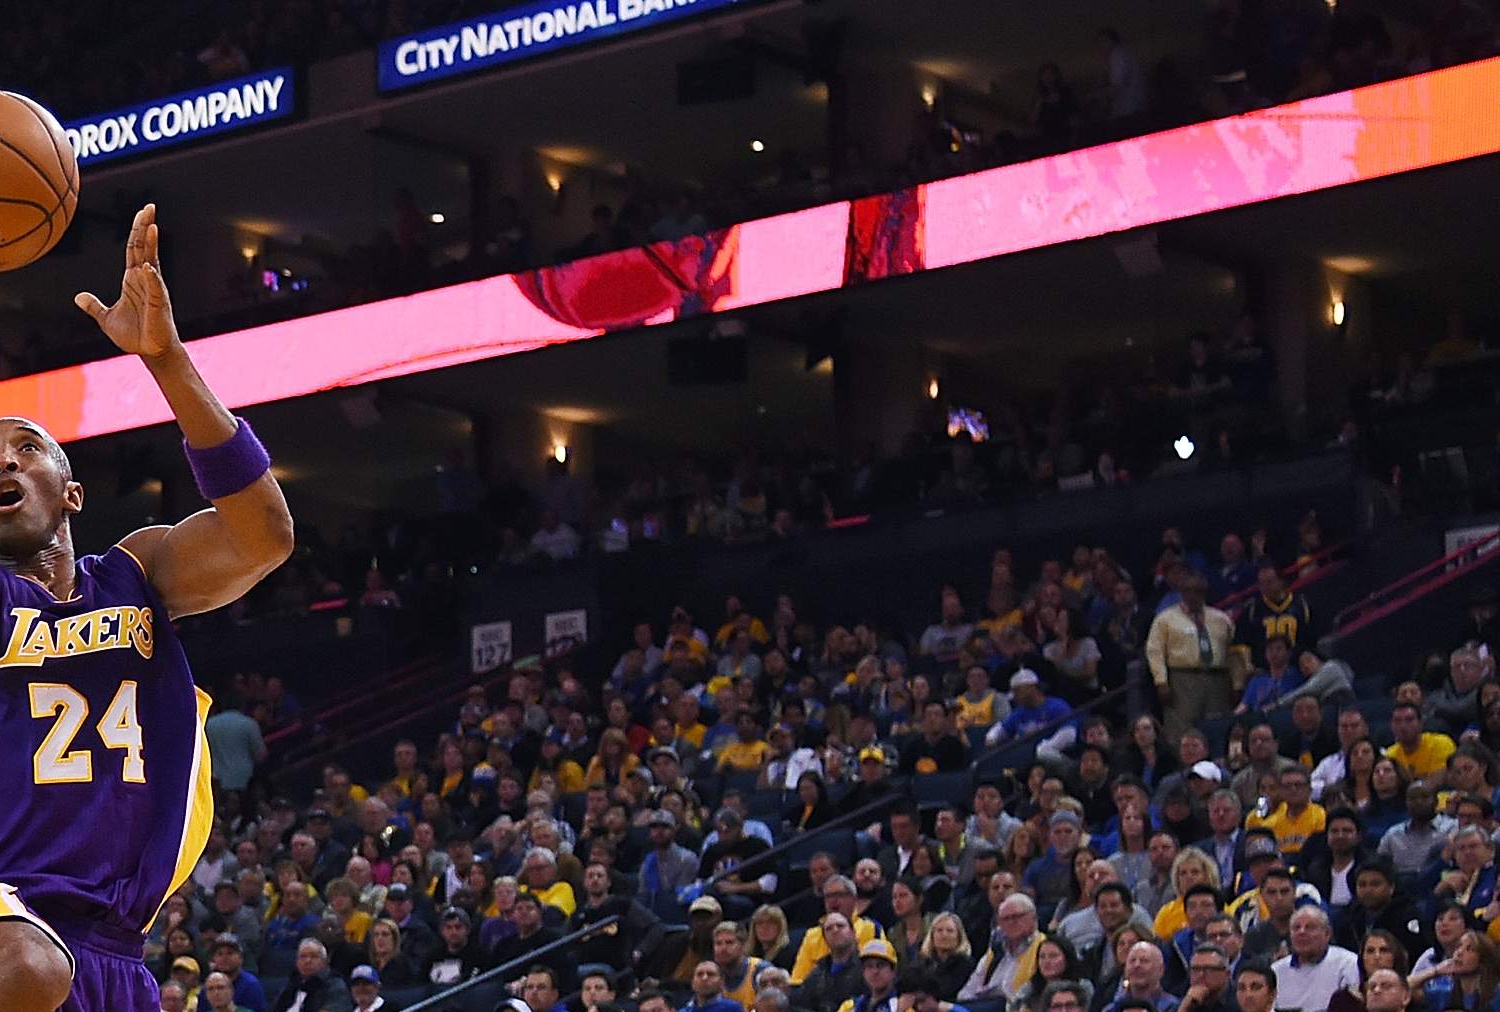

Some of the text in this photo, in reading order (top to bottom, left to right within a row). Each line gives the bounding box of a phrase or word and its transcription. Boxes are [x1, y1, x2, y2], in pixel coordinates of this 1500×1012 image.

[395, 34, 460, 76] CITY
[459, 0, 617, 62] NATIONAL
[141, 75, 285, 141] COMPANY
[28, 680, 146, 784] 24
